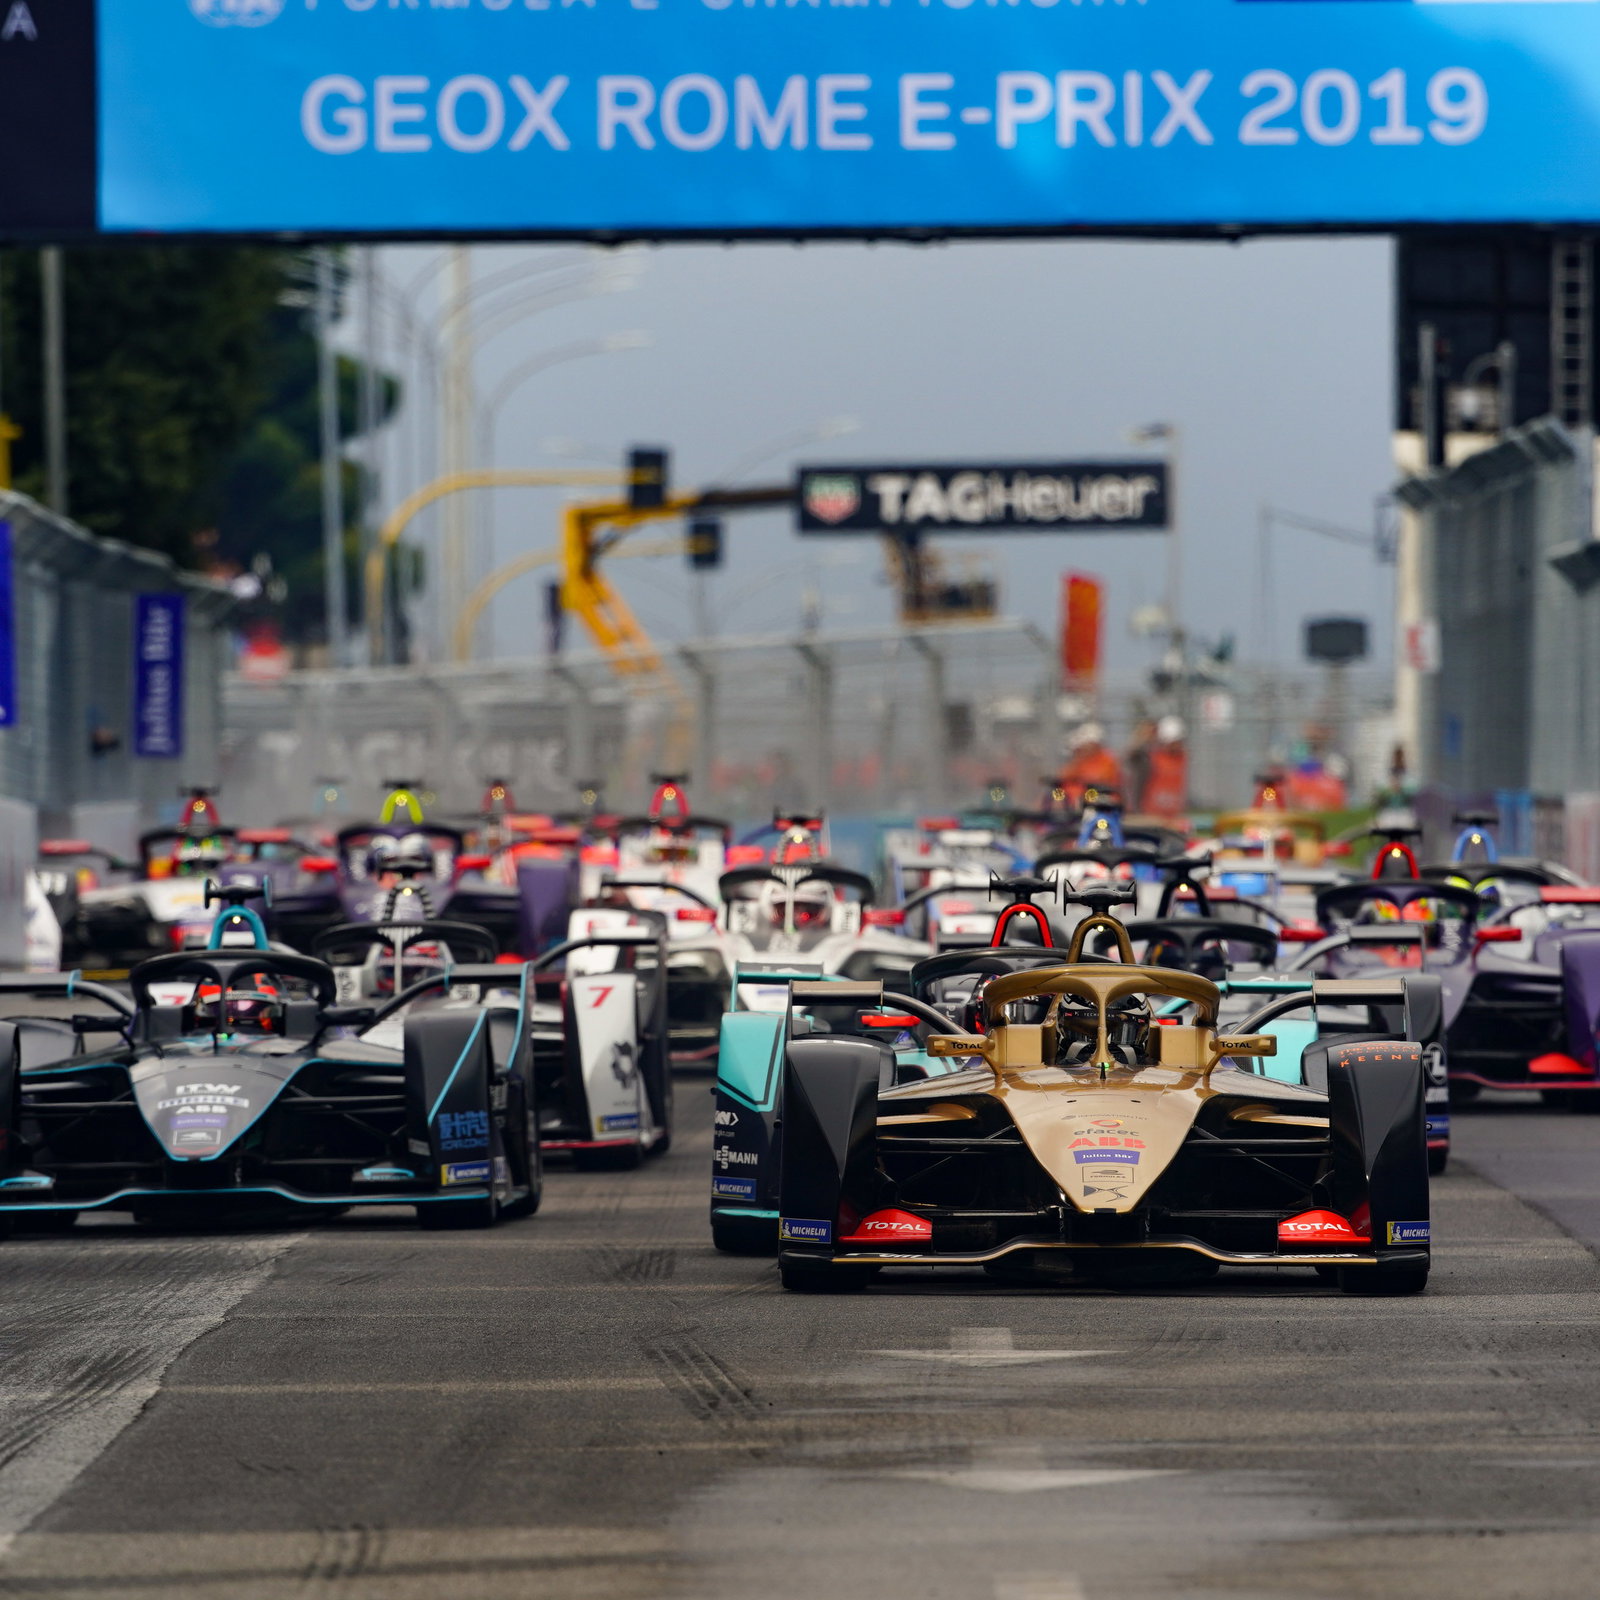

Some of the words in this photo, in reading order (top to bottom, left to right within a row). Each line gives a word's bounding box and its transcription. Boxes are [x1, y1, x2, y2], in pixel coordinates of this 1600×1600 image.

[302, 75, 568, 153] GEOX
[597, 74, 871, 150] ROME
[899, 71, 1212, 149] E-PRIX
[1239, 68, 1488, 145] 2019
[588, 985, 614, 1008] 7
[951, 1041, 983, 1050] TOTAL
[1219, 1041, 1252, 1049] TOTAL
[1339, 1054, 1420, 1068] KEENE
[176, 1083, 242, 1096] ITW
[175, 1105, 228, 1115] ABB
[1073, 1128, 1140, 1137] efacec
[1067, 1136, 1147, 1150] ABB
[719, 1182, 752, 1194] MICHELIN
[791, 1226, 827, 1237] MICHELIN
[865, 1221, 926, 1231] TOTAL
[1283, 1222, 1350, 1232] TOTAL
